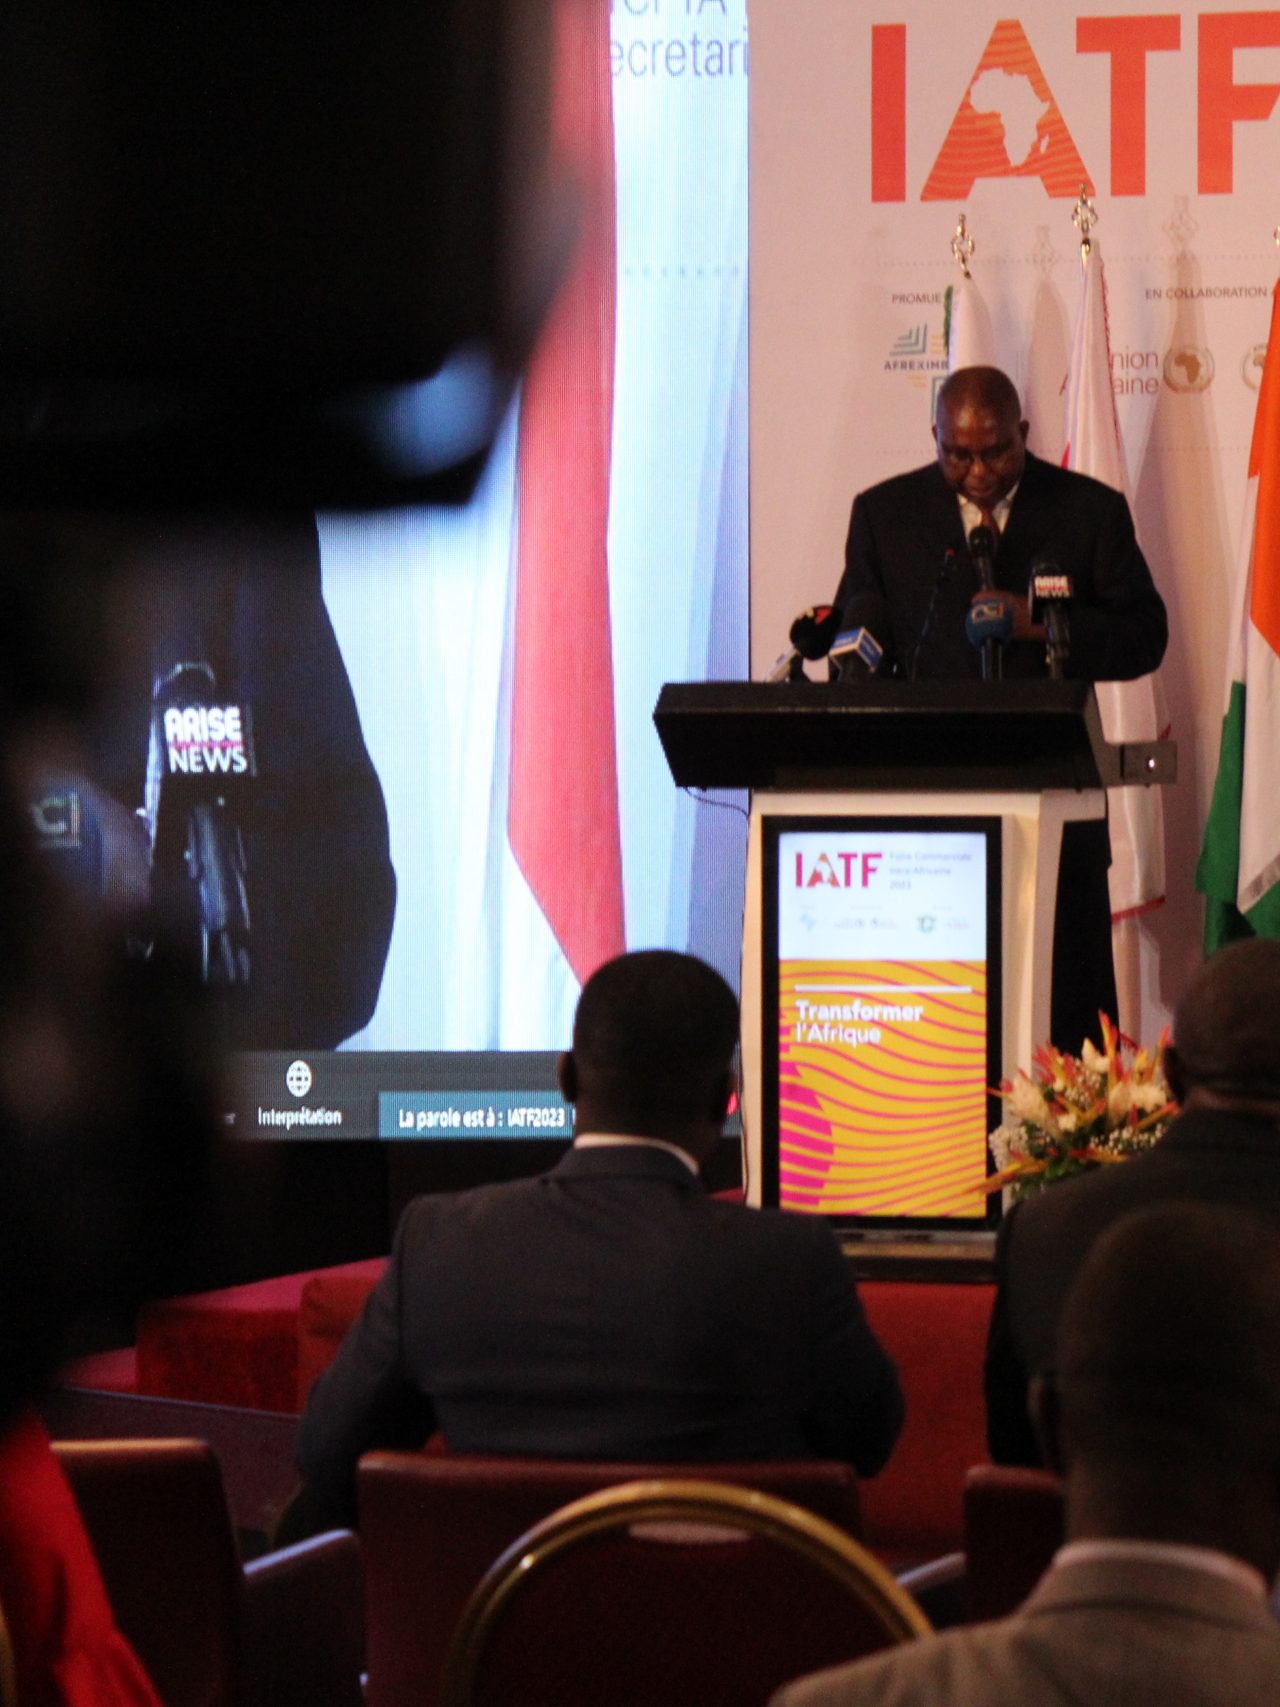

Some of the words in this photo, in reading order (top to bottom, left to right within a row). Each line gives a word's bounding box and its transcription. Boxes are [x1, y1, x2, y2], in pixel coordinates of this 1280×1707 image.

[1145, 289, 1161, 299] EN
[1166, 287, 1267, 299] COLLABORATION
[164, 707, 242, 743] ARISE
[168, 746, 248, 773] NEWS
[795, 852, 882, 889] IATF
[796, 999, 923, 1021] Transformer
[797, 1021, 881, 1048] l'Afrique
[399, 1109, 414, 1127] La
[417, 1107, 460, 1131] parole
[463, 1108, 484, 1127] est
[486, 1106, 495, 1127] à
[508, 1107, 565, 1128] IATF2023
